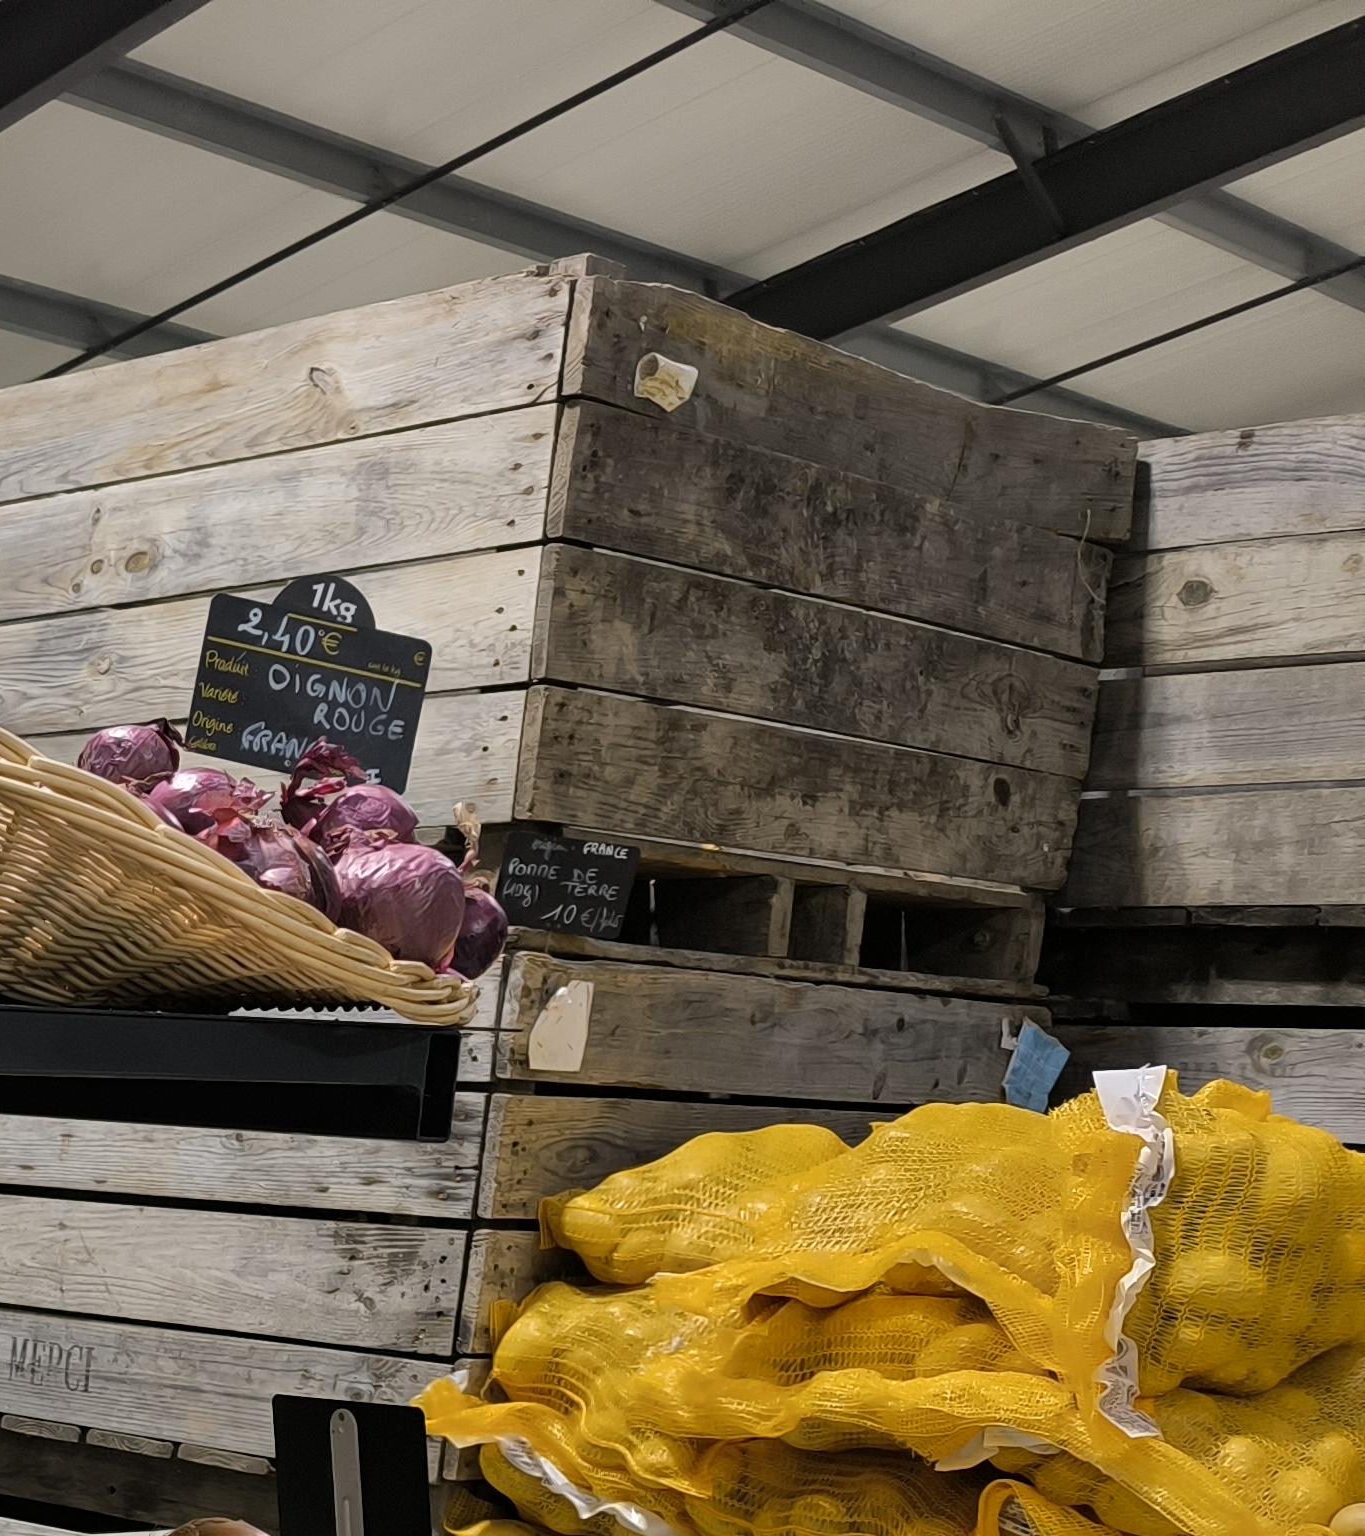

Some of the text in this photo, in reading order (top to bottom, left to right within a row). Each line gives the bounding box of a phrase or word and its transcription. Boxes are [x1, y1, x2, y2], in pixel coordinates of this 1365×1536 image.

[312, 582, 357, 623] 1kg
[238, 608, 315, 656] 2,40
[192, 710, 318, 759] Origine FRAN
[314, 702, 406, 740] ROUGE
[583, 842, 629, 859] FRANCE
[560, 881, 619, 901] TERRE
[572, 868, 598, 884] DE
